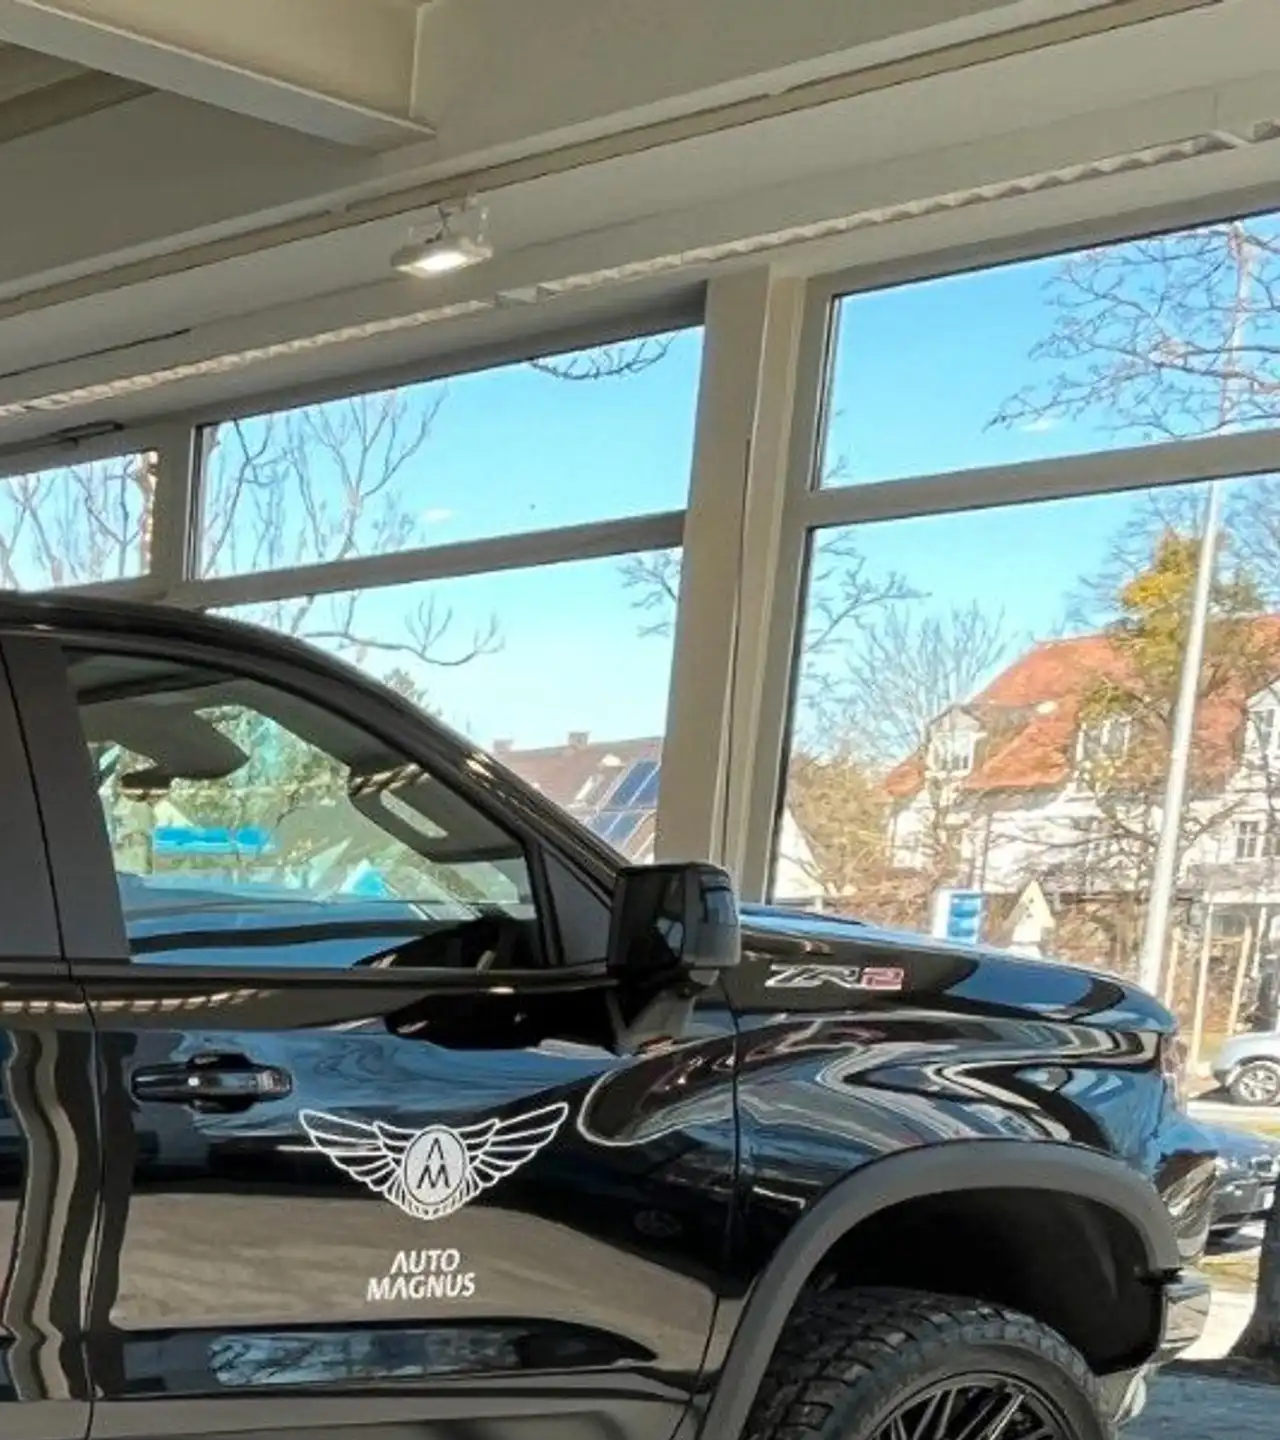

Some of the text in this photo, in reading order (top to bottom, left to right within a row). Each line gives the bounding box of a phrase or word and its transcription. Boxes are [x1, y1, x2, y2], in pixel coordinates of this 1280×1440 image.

[765, 964, 904, 990] ZR2
[390, 1248, 460, 1274] AUTO
[367, 1272, 475, 1301] MAGNUS
